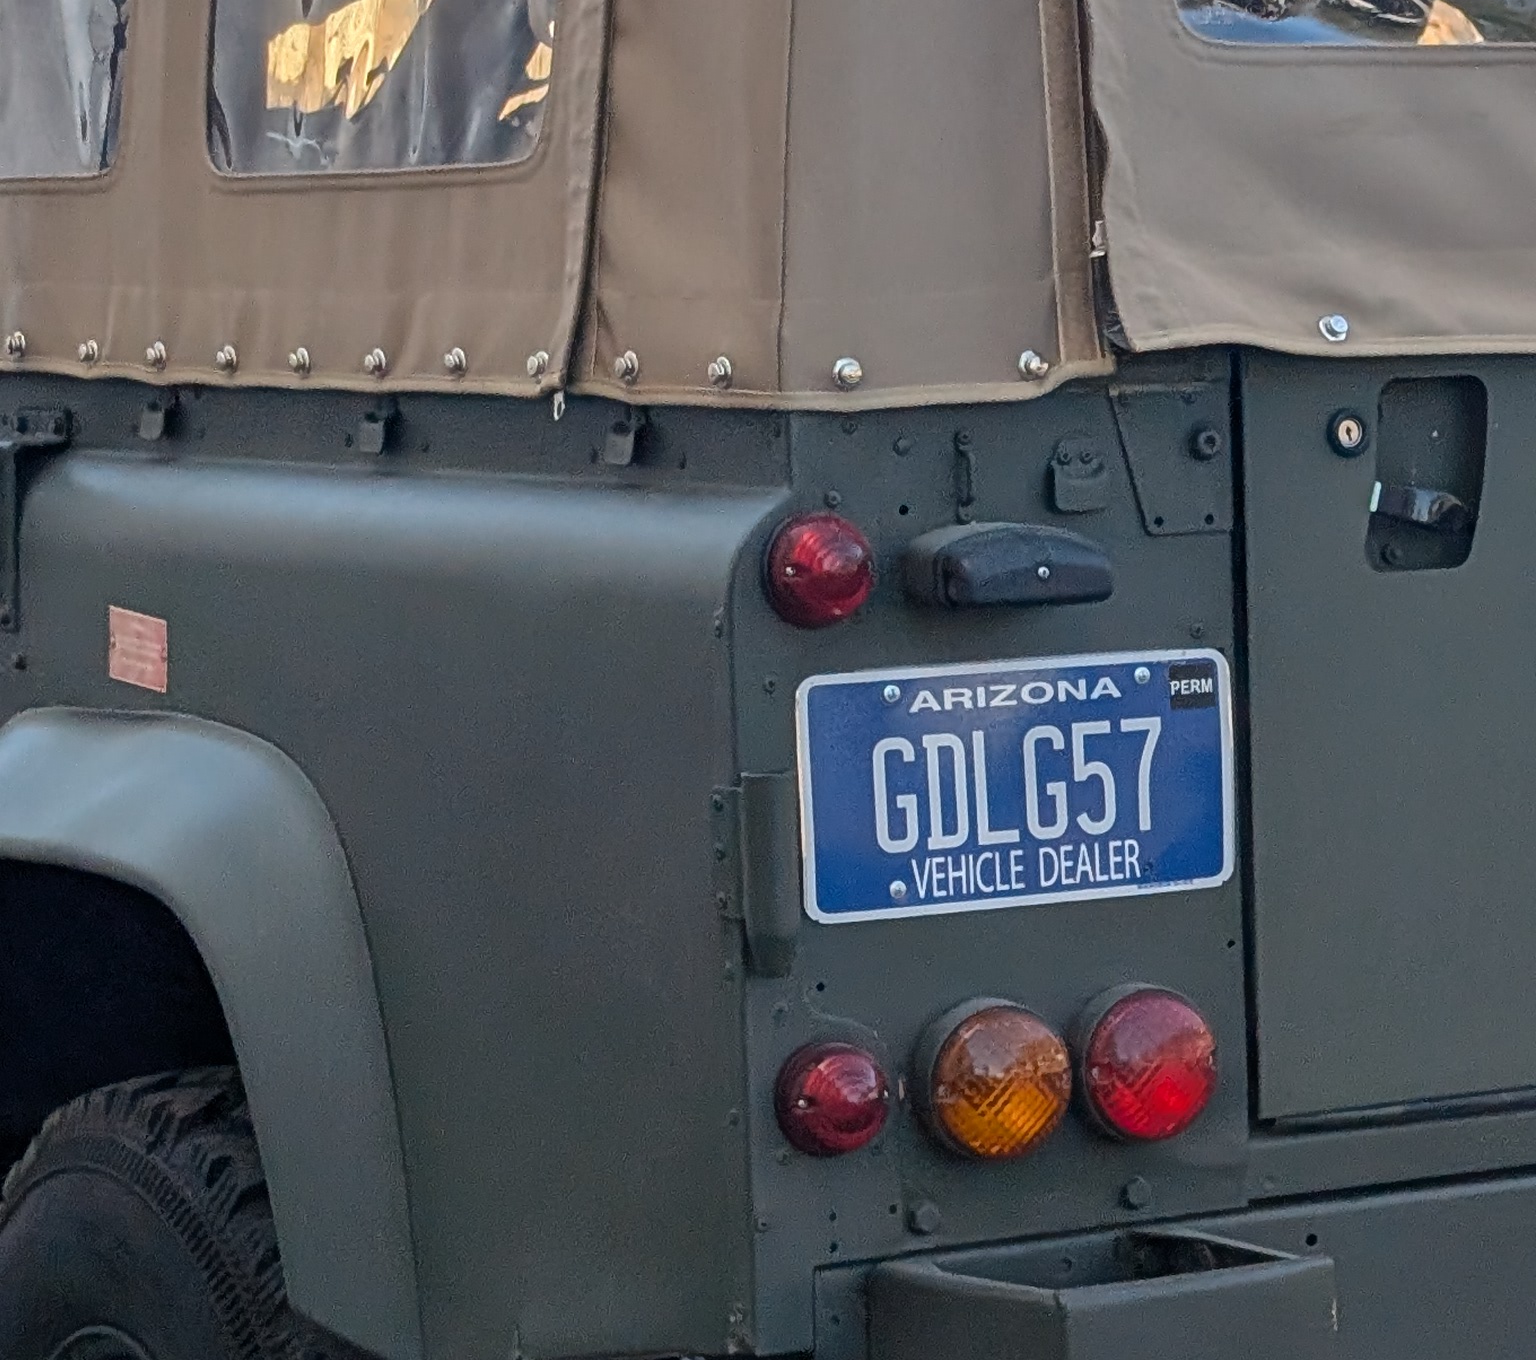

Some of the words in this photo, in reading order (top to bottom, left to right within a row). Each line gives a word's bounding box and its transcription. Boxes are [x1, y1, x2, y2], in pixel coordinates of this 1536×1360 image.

[909, 676, 1121, 713] ARIZONA
[1170, 678, 1213, 695] PERM
[872, 717, 1162, 854] GDLG57
[912, 850, 1025, 899] VEHICLE
[1039, 839, 1141, 887] DEALER
